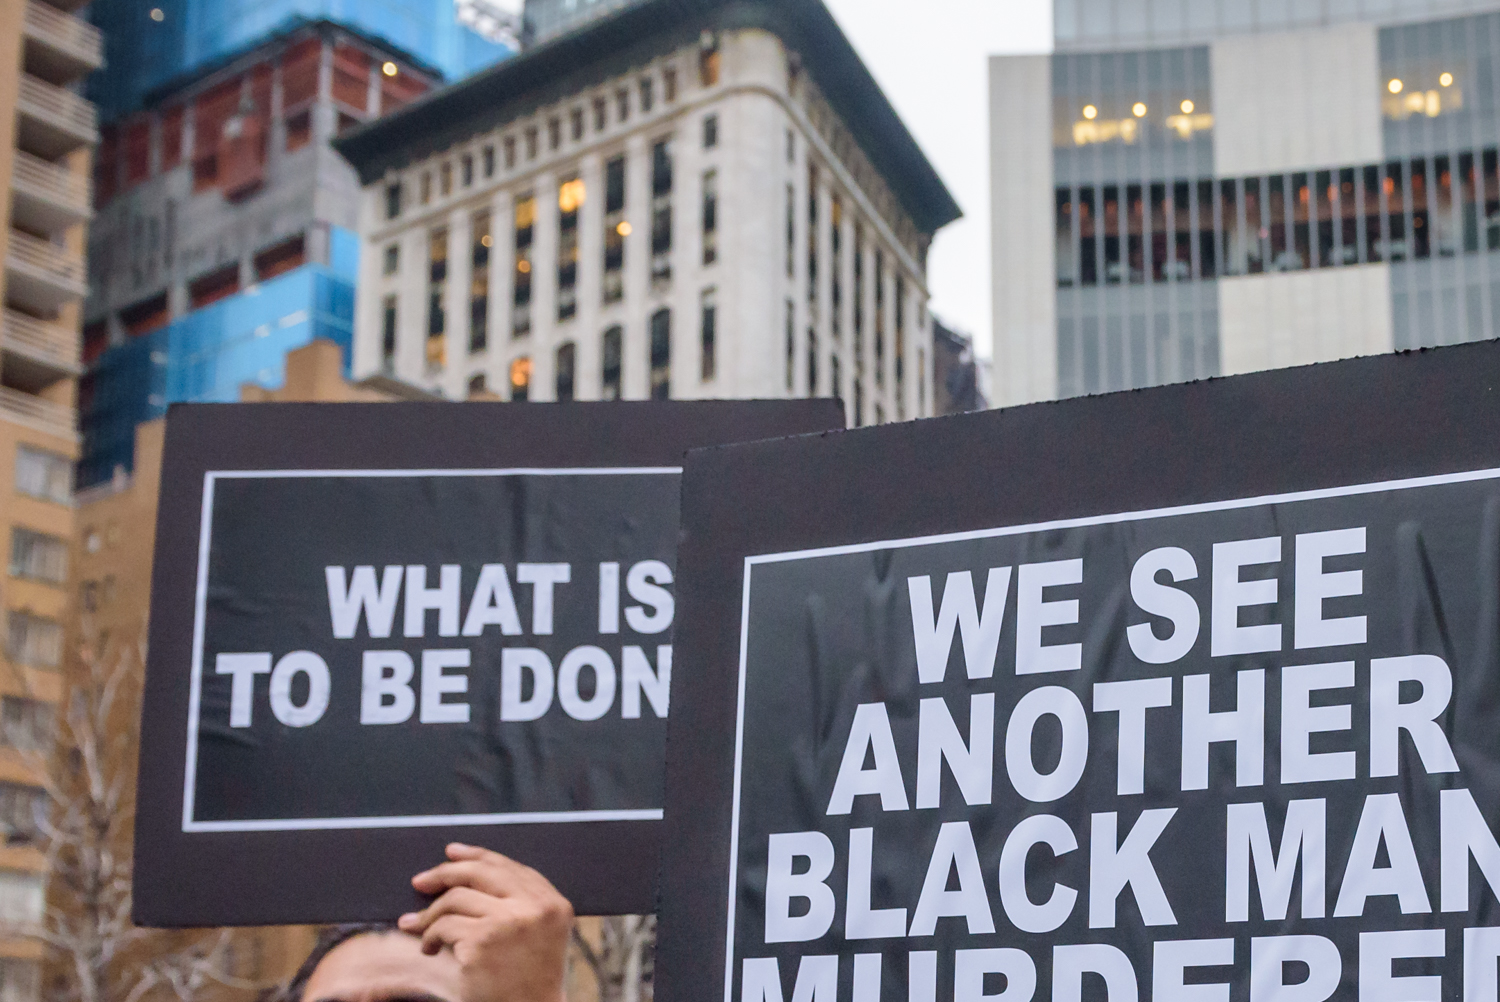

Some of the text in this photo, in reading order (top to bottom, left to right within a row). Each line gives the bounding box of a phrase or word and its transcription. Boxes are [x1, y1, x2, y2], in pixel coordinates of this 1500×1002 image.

[325, 560, 674, 639] WHAT IS
[908, 526, 1367, 684] WE SEE
[215, 644, 672, 728] TO BE DON
[826, 654, 1460, 815] ANOTHER
[764, 807, 1179, 944] BLACK
